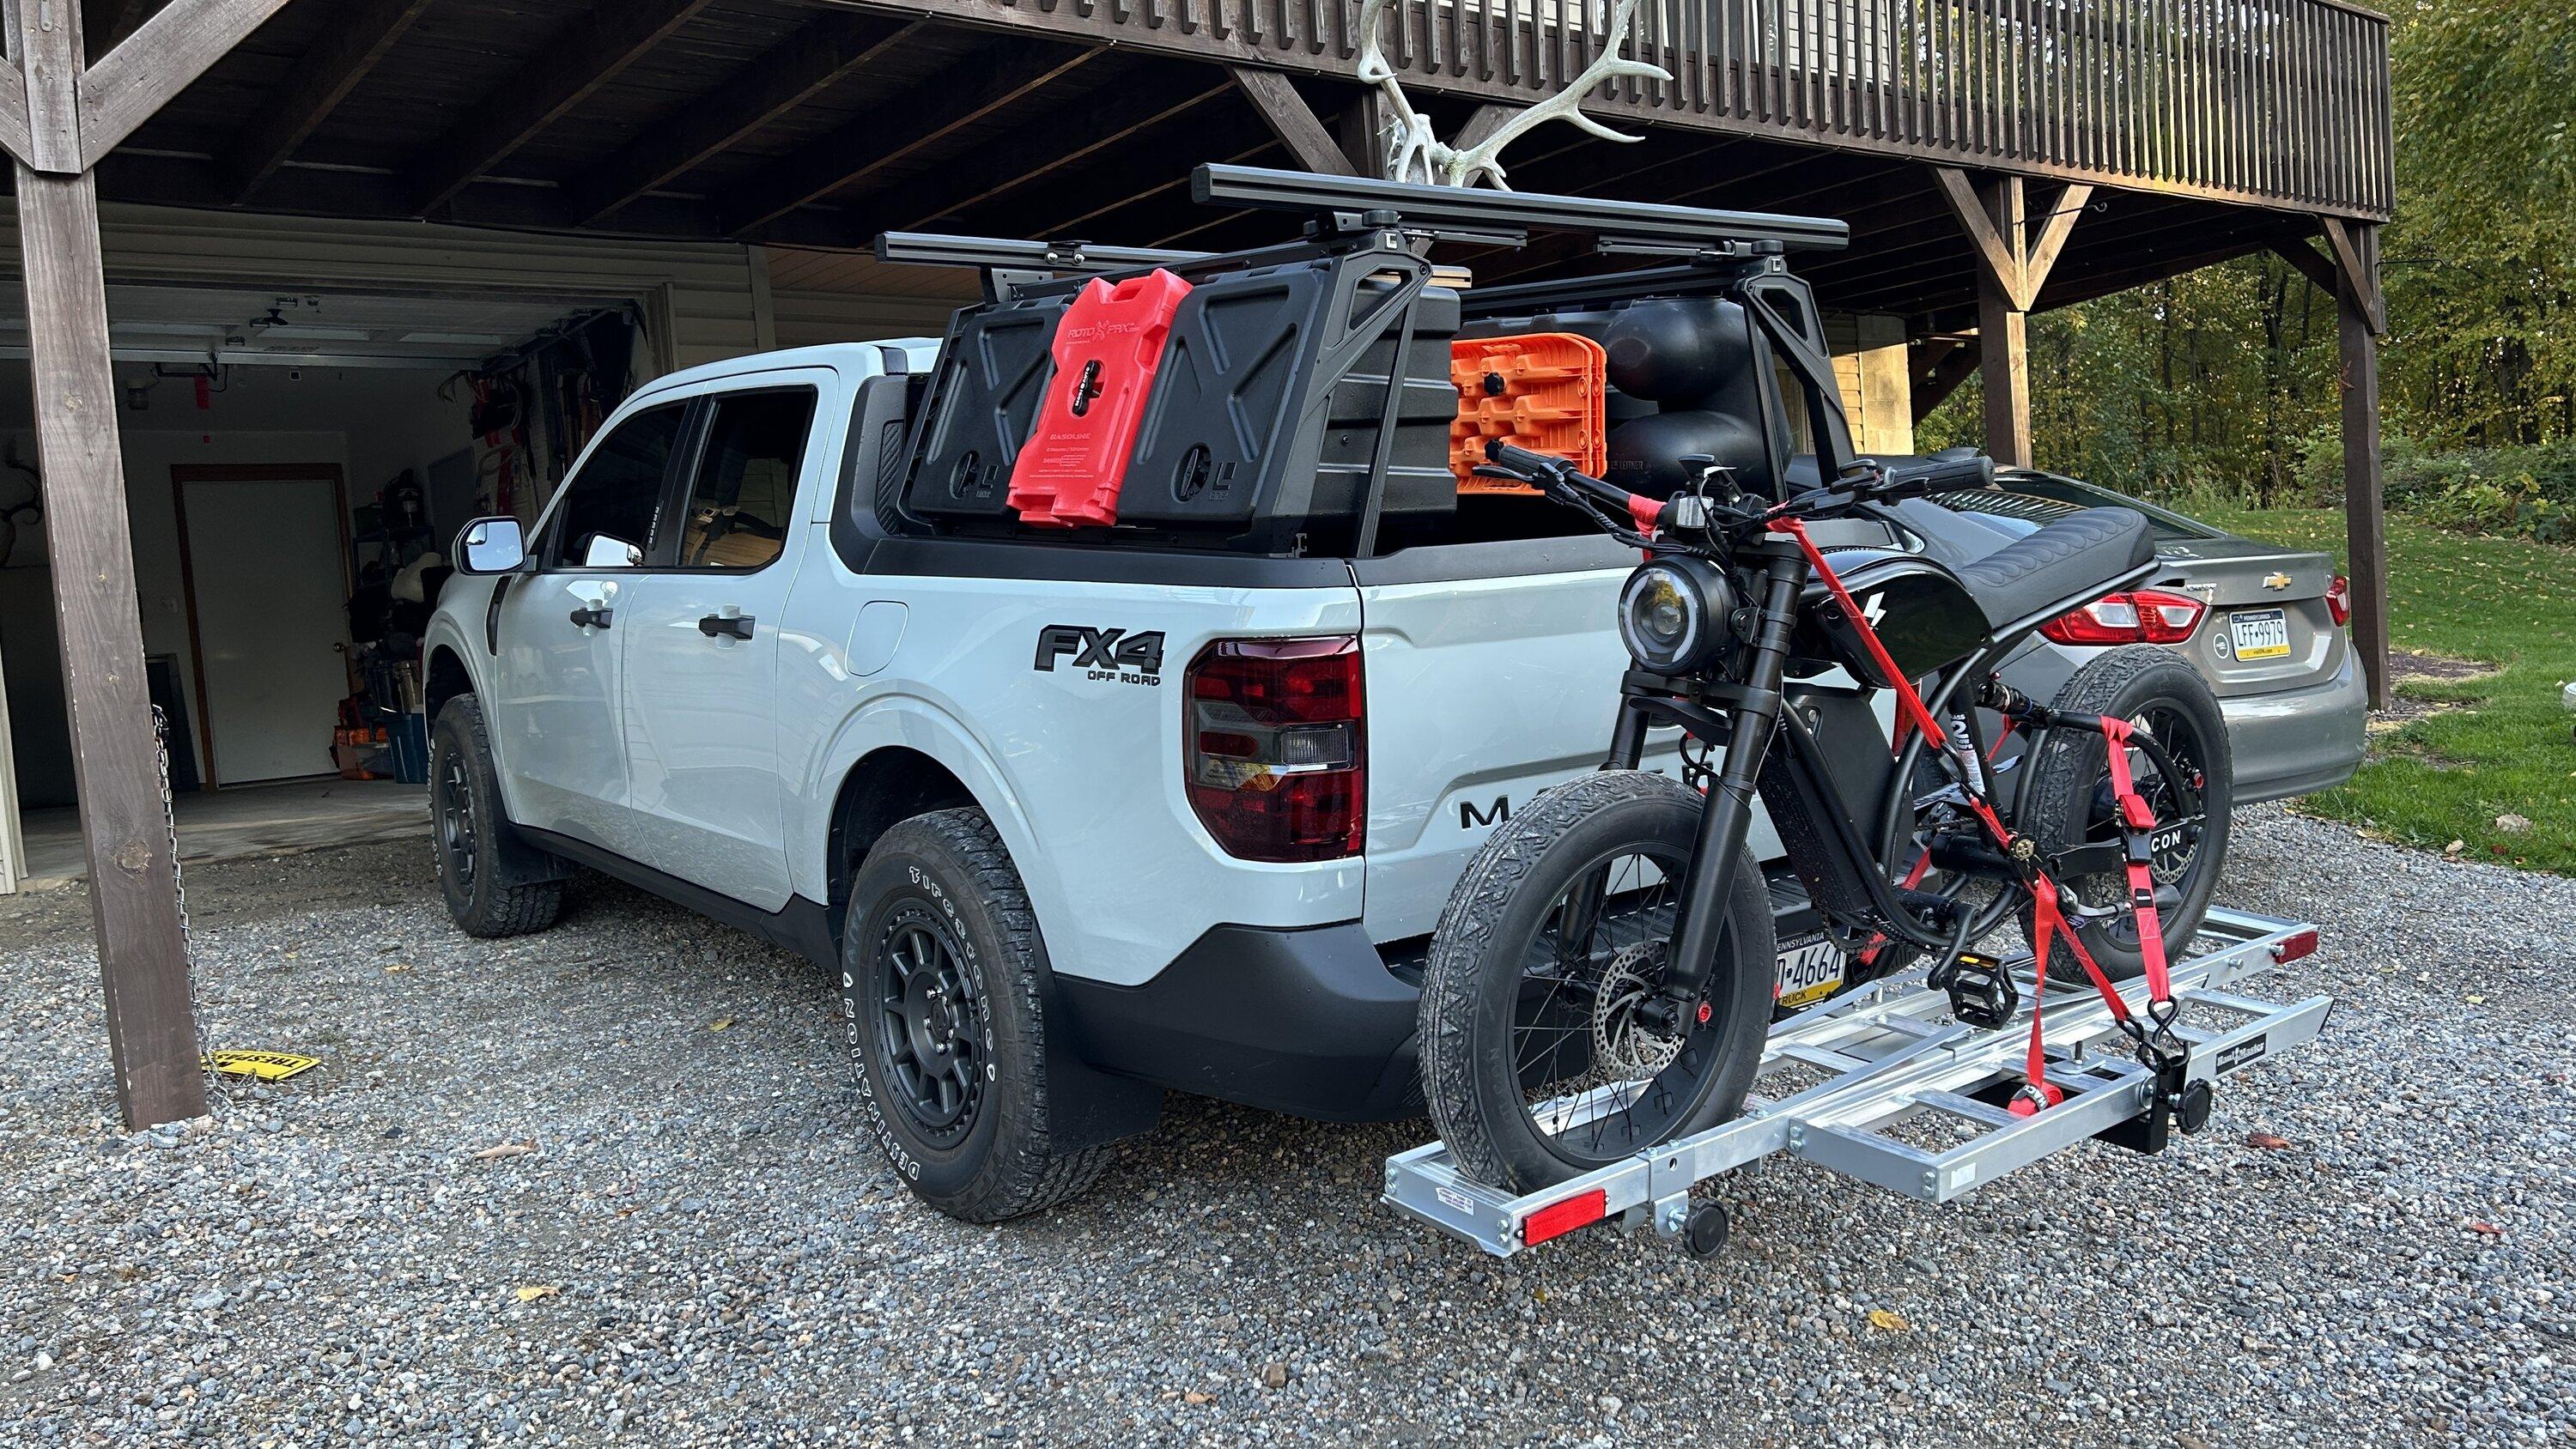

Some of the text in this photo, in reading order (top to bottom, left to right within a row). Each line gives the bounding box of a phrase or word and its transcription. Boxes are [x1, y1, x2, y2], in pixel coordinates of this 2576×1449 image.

[1034, 624, 1166, 675] FX4
[1087, 670, 1161, 687] OFF ROAD
[2151, 829, 2181, 852] CON
[1777, 931, 1825, 952] ENNSYLVANIA
[1781, 989, 1807, 1005] RUCK
[215, 1053, 301, 1068] TRESPAS
[844, 997, 920, 1181] DESTINATION
